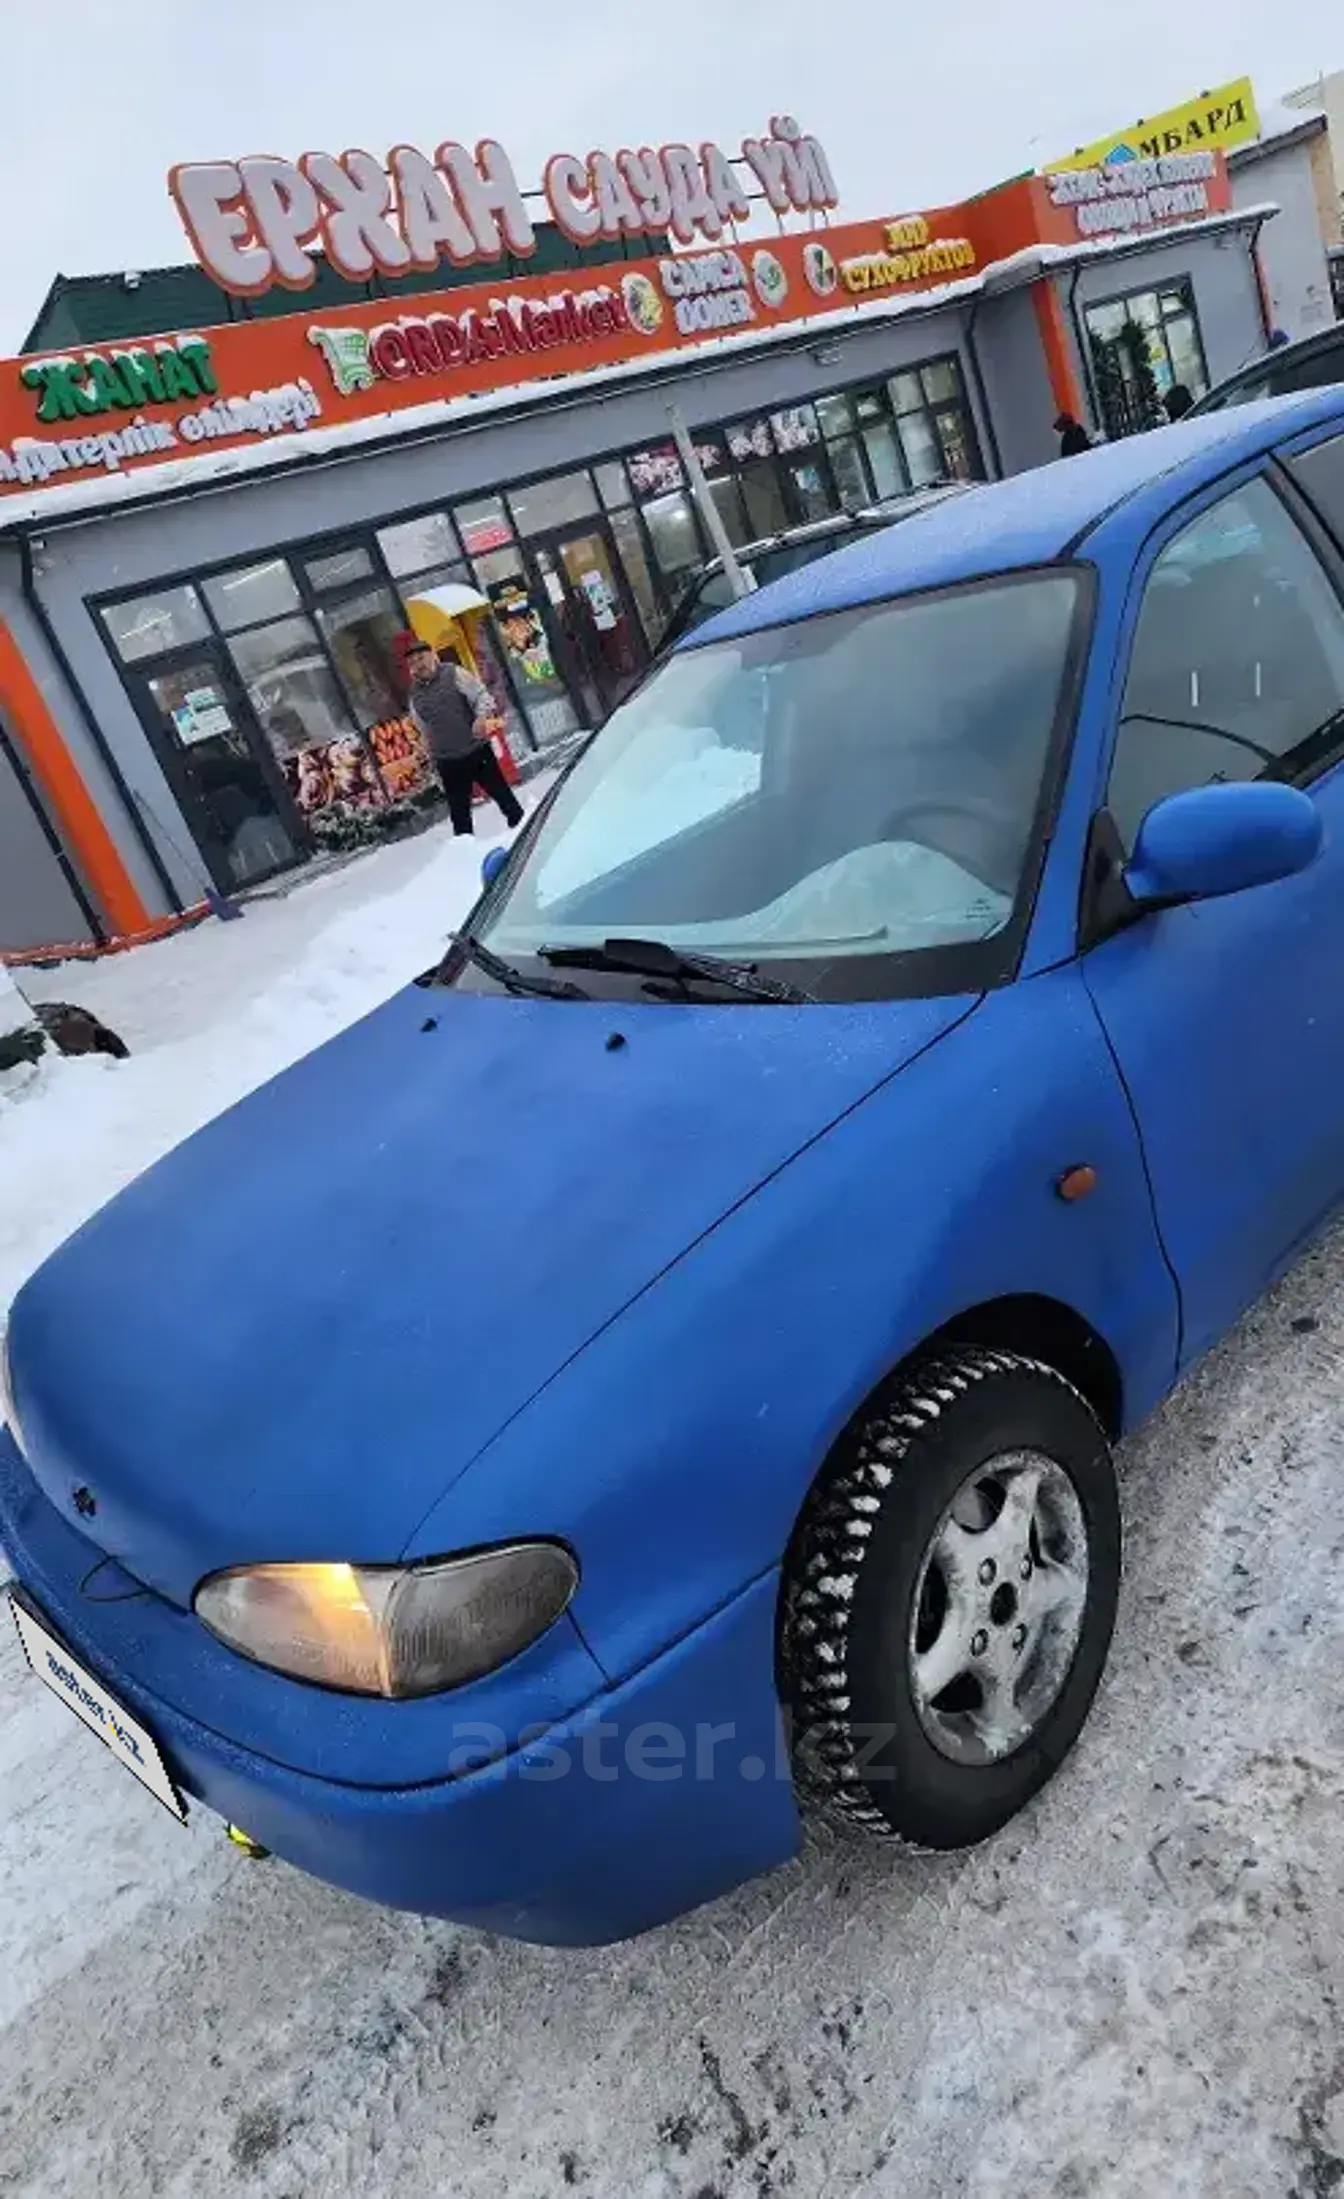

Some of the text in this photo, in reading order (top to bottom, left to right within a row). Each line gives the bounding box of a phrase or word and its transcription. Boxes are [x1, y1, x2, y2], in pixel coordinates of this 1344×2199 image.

[168, 138, 535, 296] ЕРХАН
[543, 142, 750, 246] САУДА
[840, 238, 976, 292] СУХОФРУКТОВ
[20, 335, 218, 422] ЖАНАТ
